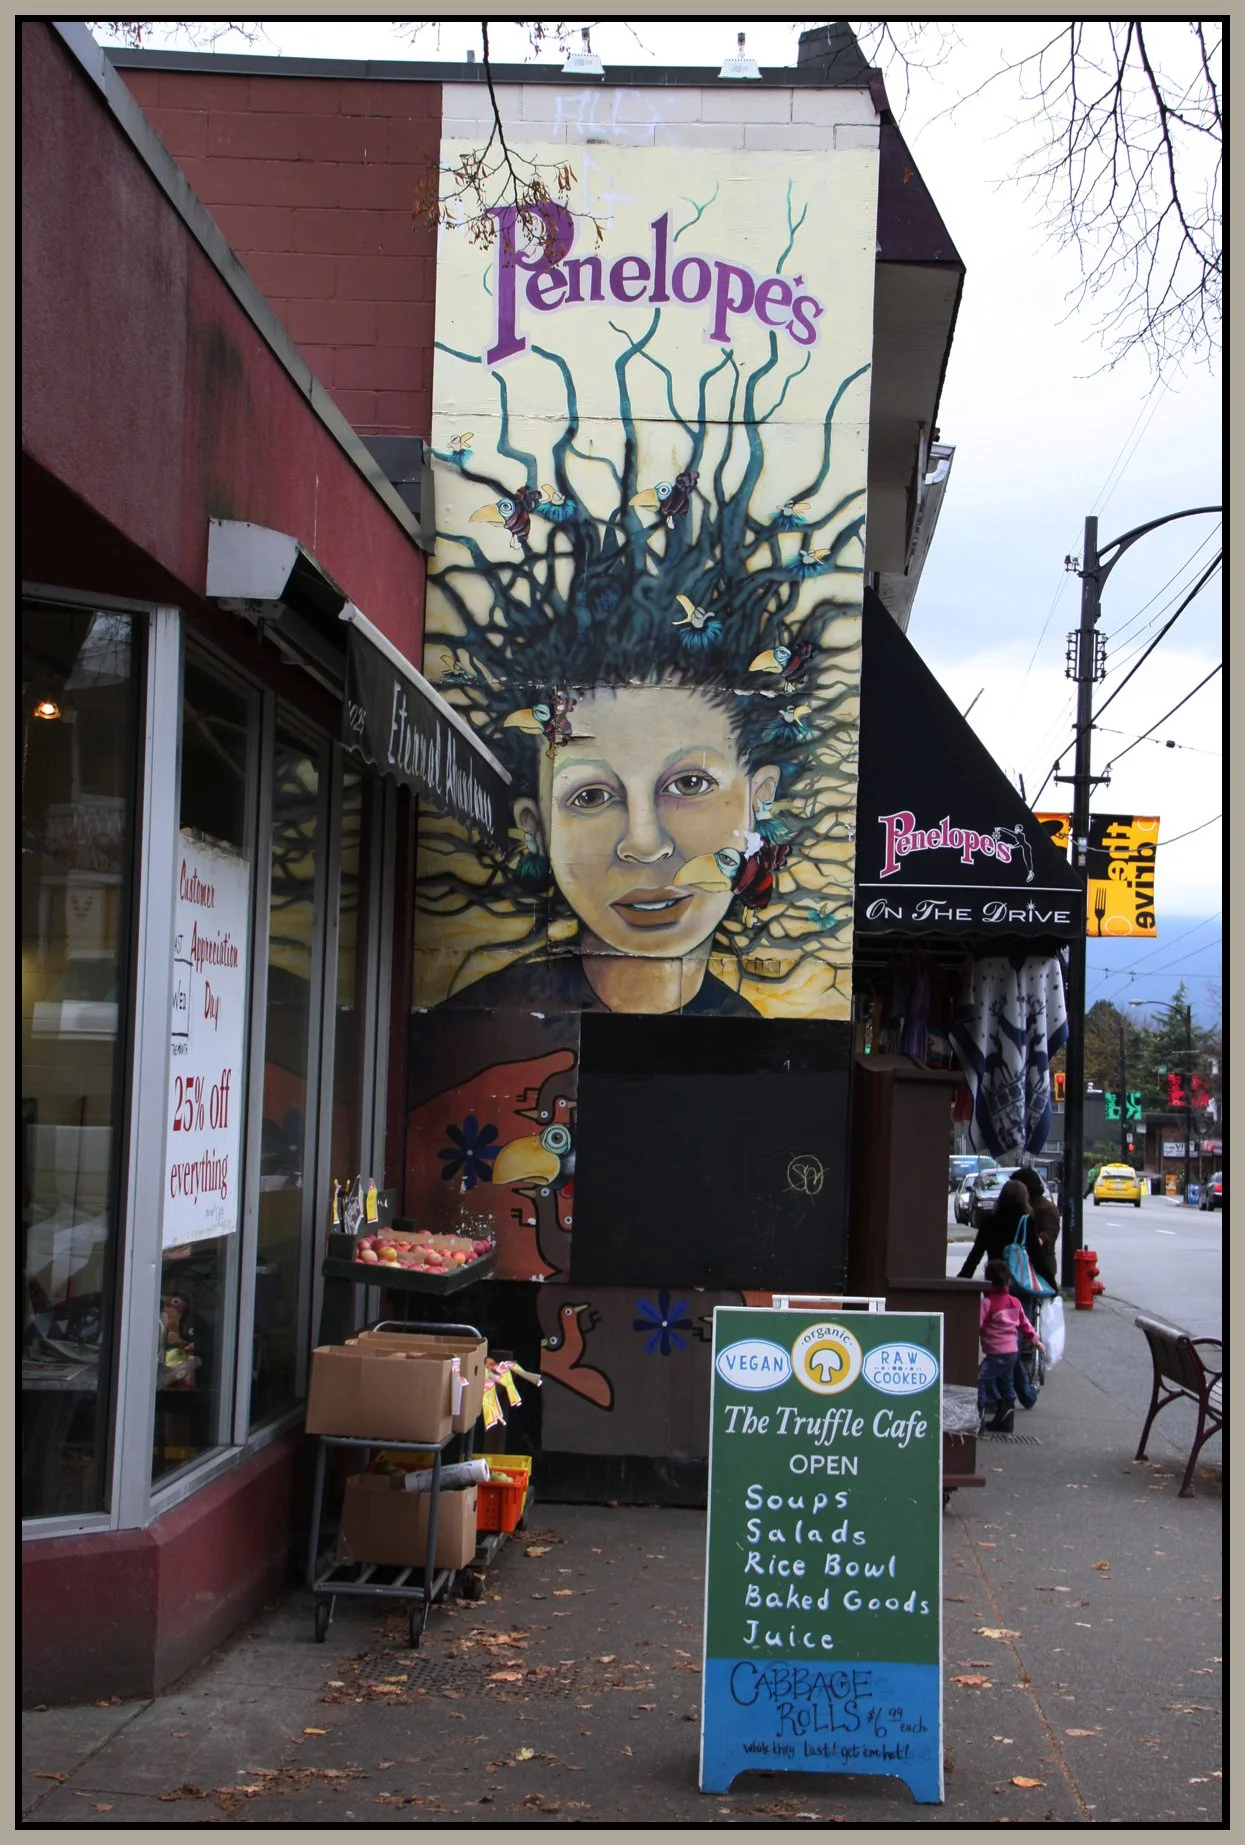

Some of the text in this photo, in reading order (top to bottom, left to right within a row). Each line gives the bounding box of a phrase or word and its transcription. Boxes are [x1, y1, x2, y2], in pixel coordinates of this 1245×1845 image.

[484, 200, 824, 366] Penelope's
[388, 680, 442, 794] Eternal
[878, 810, 1013, 879] Penelope's
[179, 857, 215, 909] Customer
[190, 920, 239, 974] Appreciation
[172, 1068, 232, 1132] 25% off
[170, 1148, 229, 1205] everything
[803, 1326, 852, 1344] organic
[726, 1354, 784, 1372] VEGAN
[881, 1351, 918, 1365] RAW
[873, 1371, 928, 1385] COOKED
[724, 1405, 928, 1449] The Truffle Cafe
[789, 1454, 858, 1476] OPEN
[745, 1484, 849, 1514] Soups
[746, 1518, 867, 1545] Salads
[744, 1551, 897, 1578] Rice Bowl
[744, 1584, 930, 1615] Baked Goods
[743, 1620, 834, 1649] Juice
[730, 1661, 873, 1706] CABBAGE
[776, 1700, 861, 1738] ROLLS
[803, 1740, 836, 1758] last!
